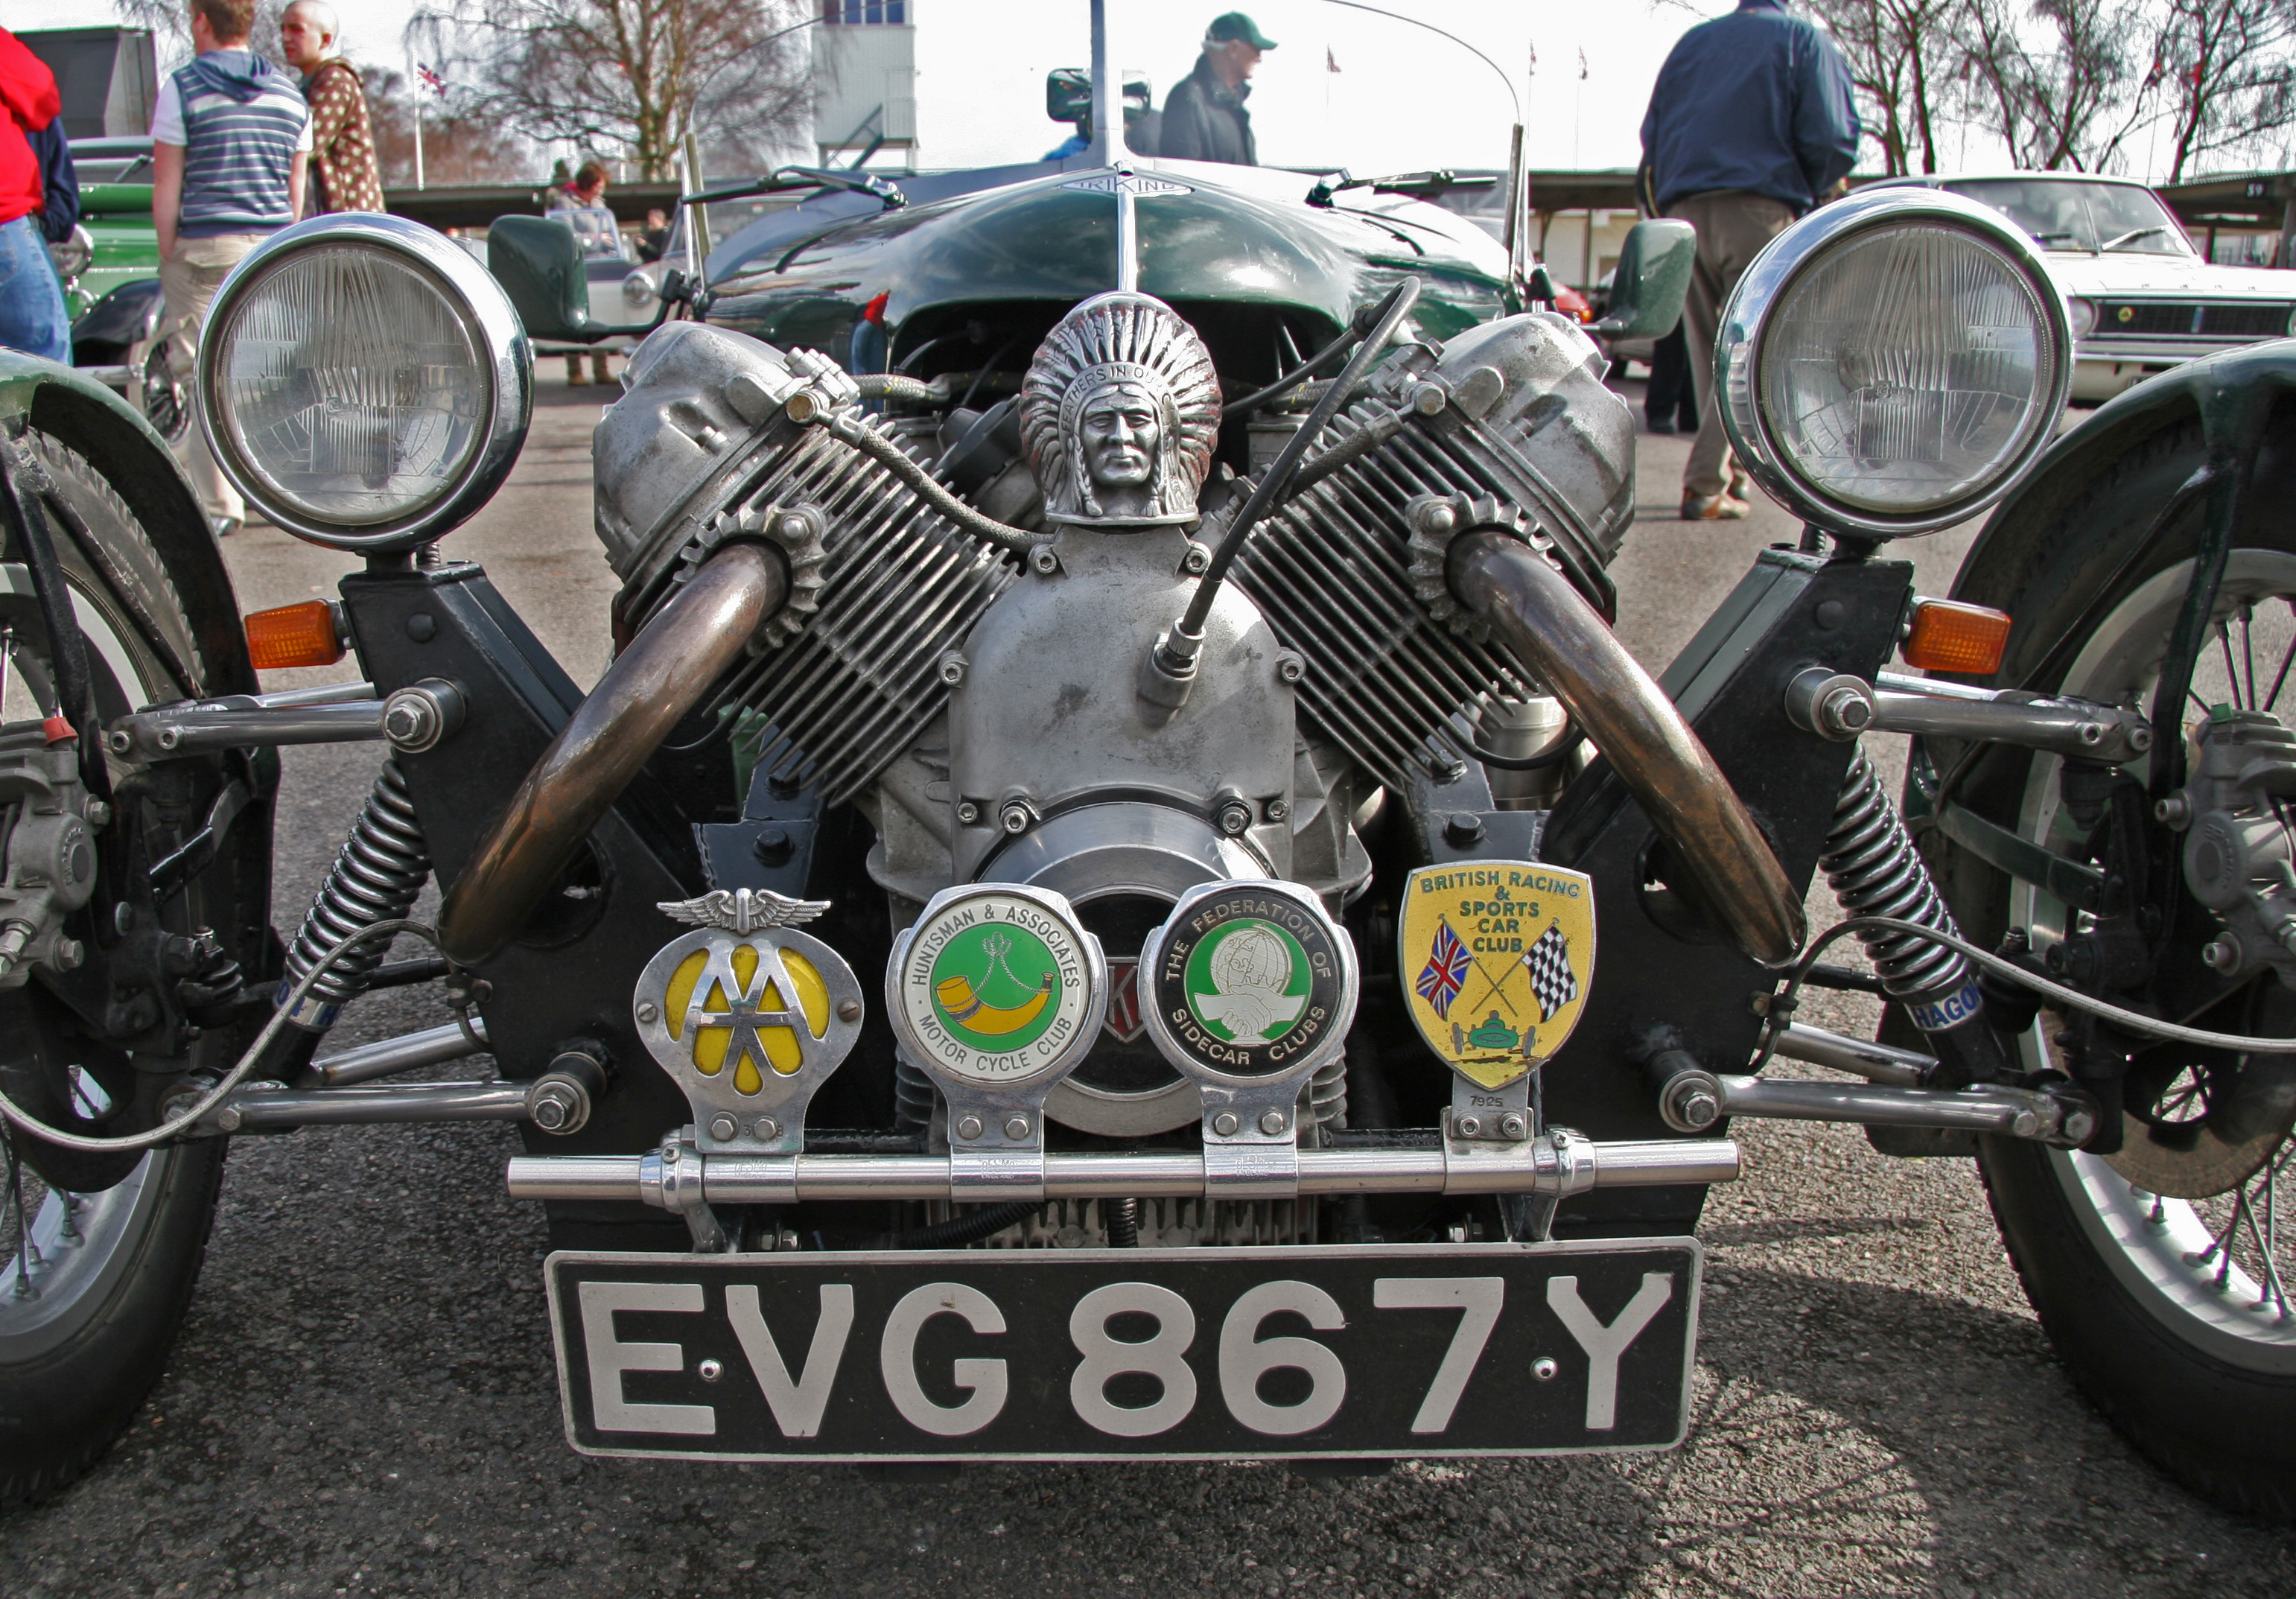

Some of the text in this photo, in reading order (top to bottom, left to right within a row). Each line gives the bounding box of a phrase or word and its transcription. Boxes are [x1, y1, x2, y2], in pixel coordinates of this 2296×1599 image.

[1078, 174, 1176, 194] TRIKING
[1061, 367, 1107, 433] FEATHERS
[1111, 366, 1127, 378] IN
[1421, 871, 1580, 899] BRITISH RACING
[1495, 885, 1510, 900] &
[1460, 900, 1539, 918] SPORTS
[1478, 918, 1519, 933] CAR
[912, 904, 1080, 988] HUNTSMAN & ASSOCIATES
[1166, 900, 1331, 981] THE FEDERATION OF
[1472, 937, 1523, 953] CLUB
[679, 940, 813, 1074] AA
[919, 1014, 1072, 1072] MOTOR CYCLE CLUB
[1172, 1006, 1326, 1065] SIDECAR CLUBS
[1470, 1096, 1503, 1107] 7925
[579, 1273, 1672, 1437] EVG 867Y
